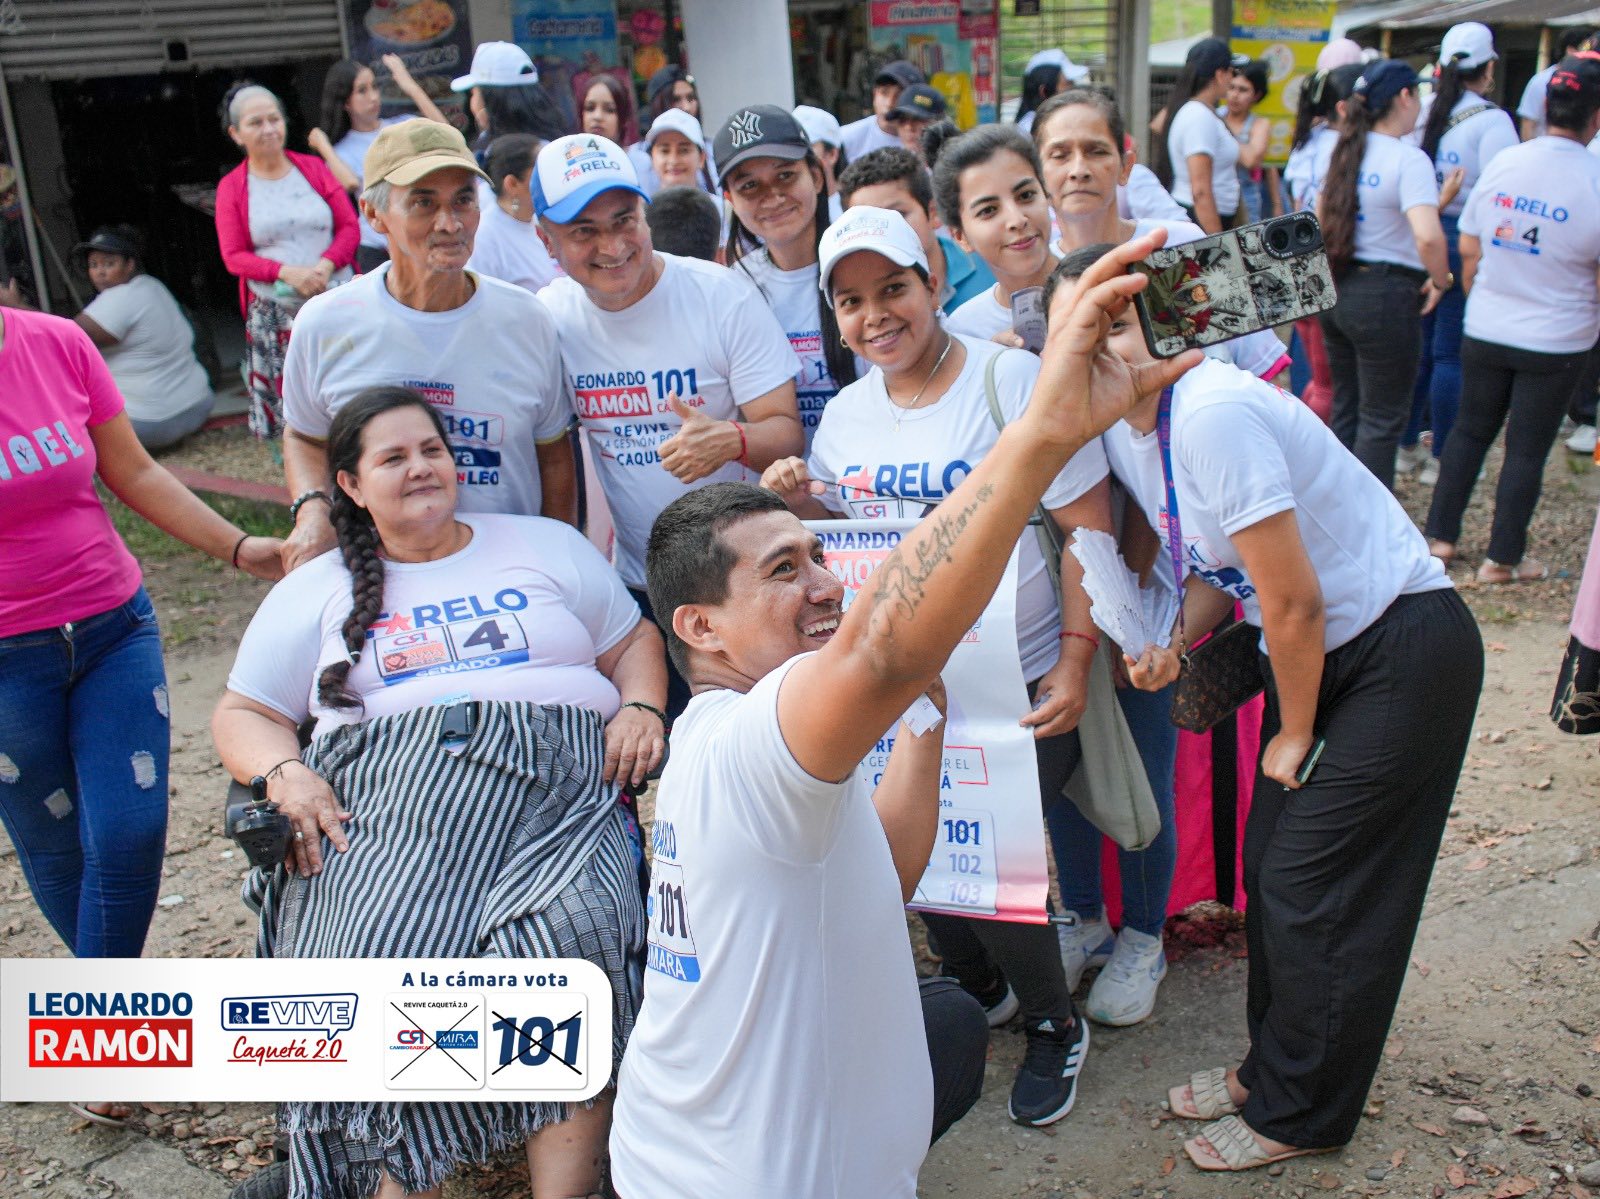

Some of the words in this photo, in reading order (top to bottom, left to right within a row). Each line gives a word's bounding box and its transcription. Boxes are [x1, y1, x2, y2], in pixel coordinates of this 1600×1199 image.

[587, 139, 600, 150] 4
[1522, 226, 1539, 245] 4
[402, 381, 455, 391] LEONARDO
[570, 370, 645, 389] LEONARDO
[652, 368, 698, 399] 101
[424, 391, 453, 405] MÓN
[576, 389, 651, 416] RAMÓN
[445, 415, 488, 441] 101
[463, 619, 510, 650] 4
[416, 656, 501, 678] SENADO
[956, 758, 970, 770] EL
[944, 819, 981, 845] 101
[949, 853, 982, 875] 102
[950, 882, 982, 905] 103
[659, 881, 688, 939] 101
